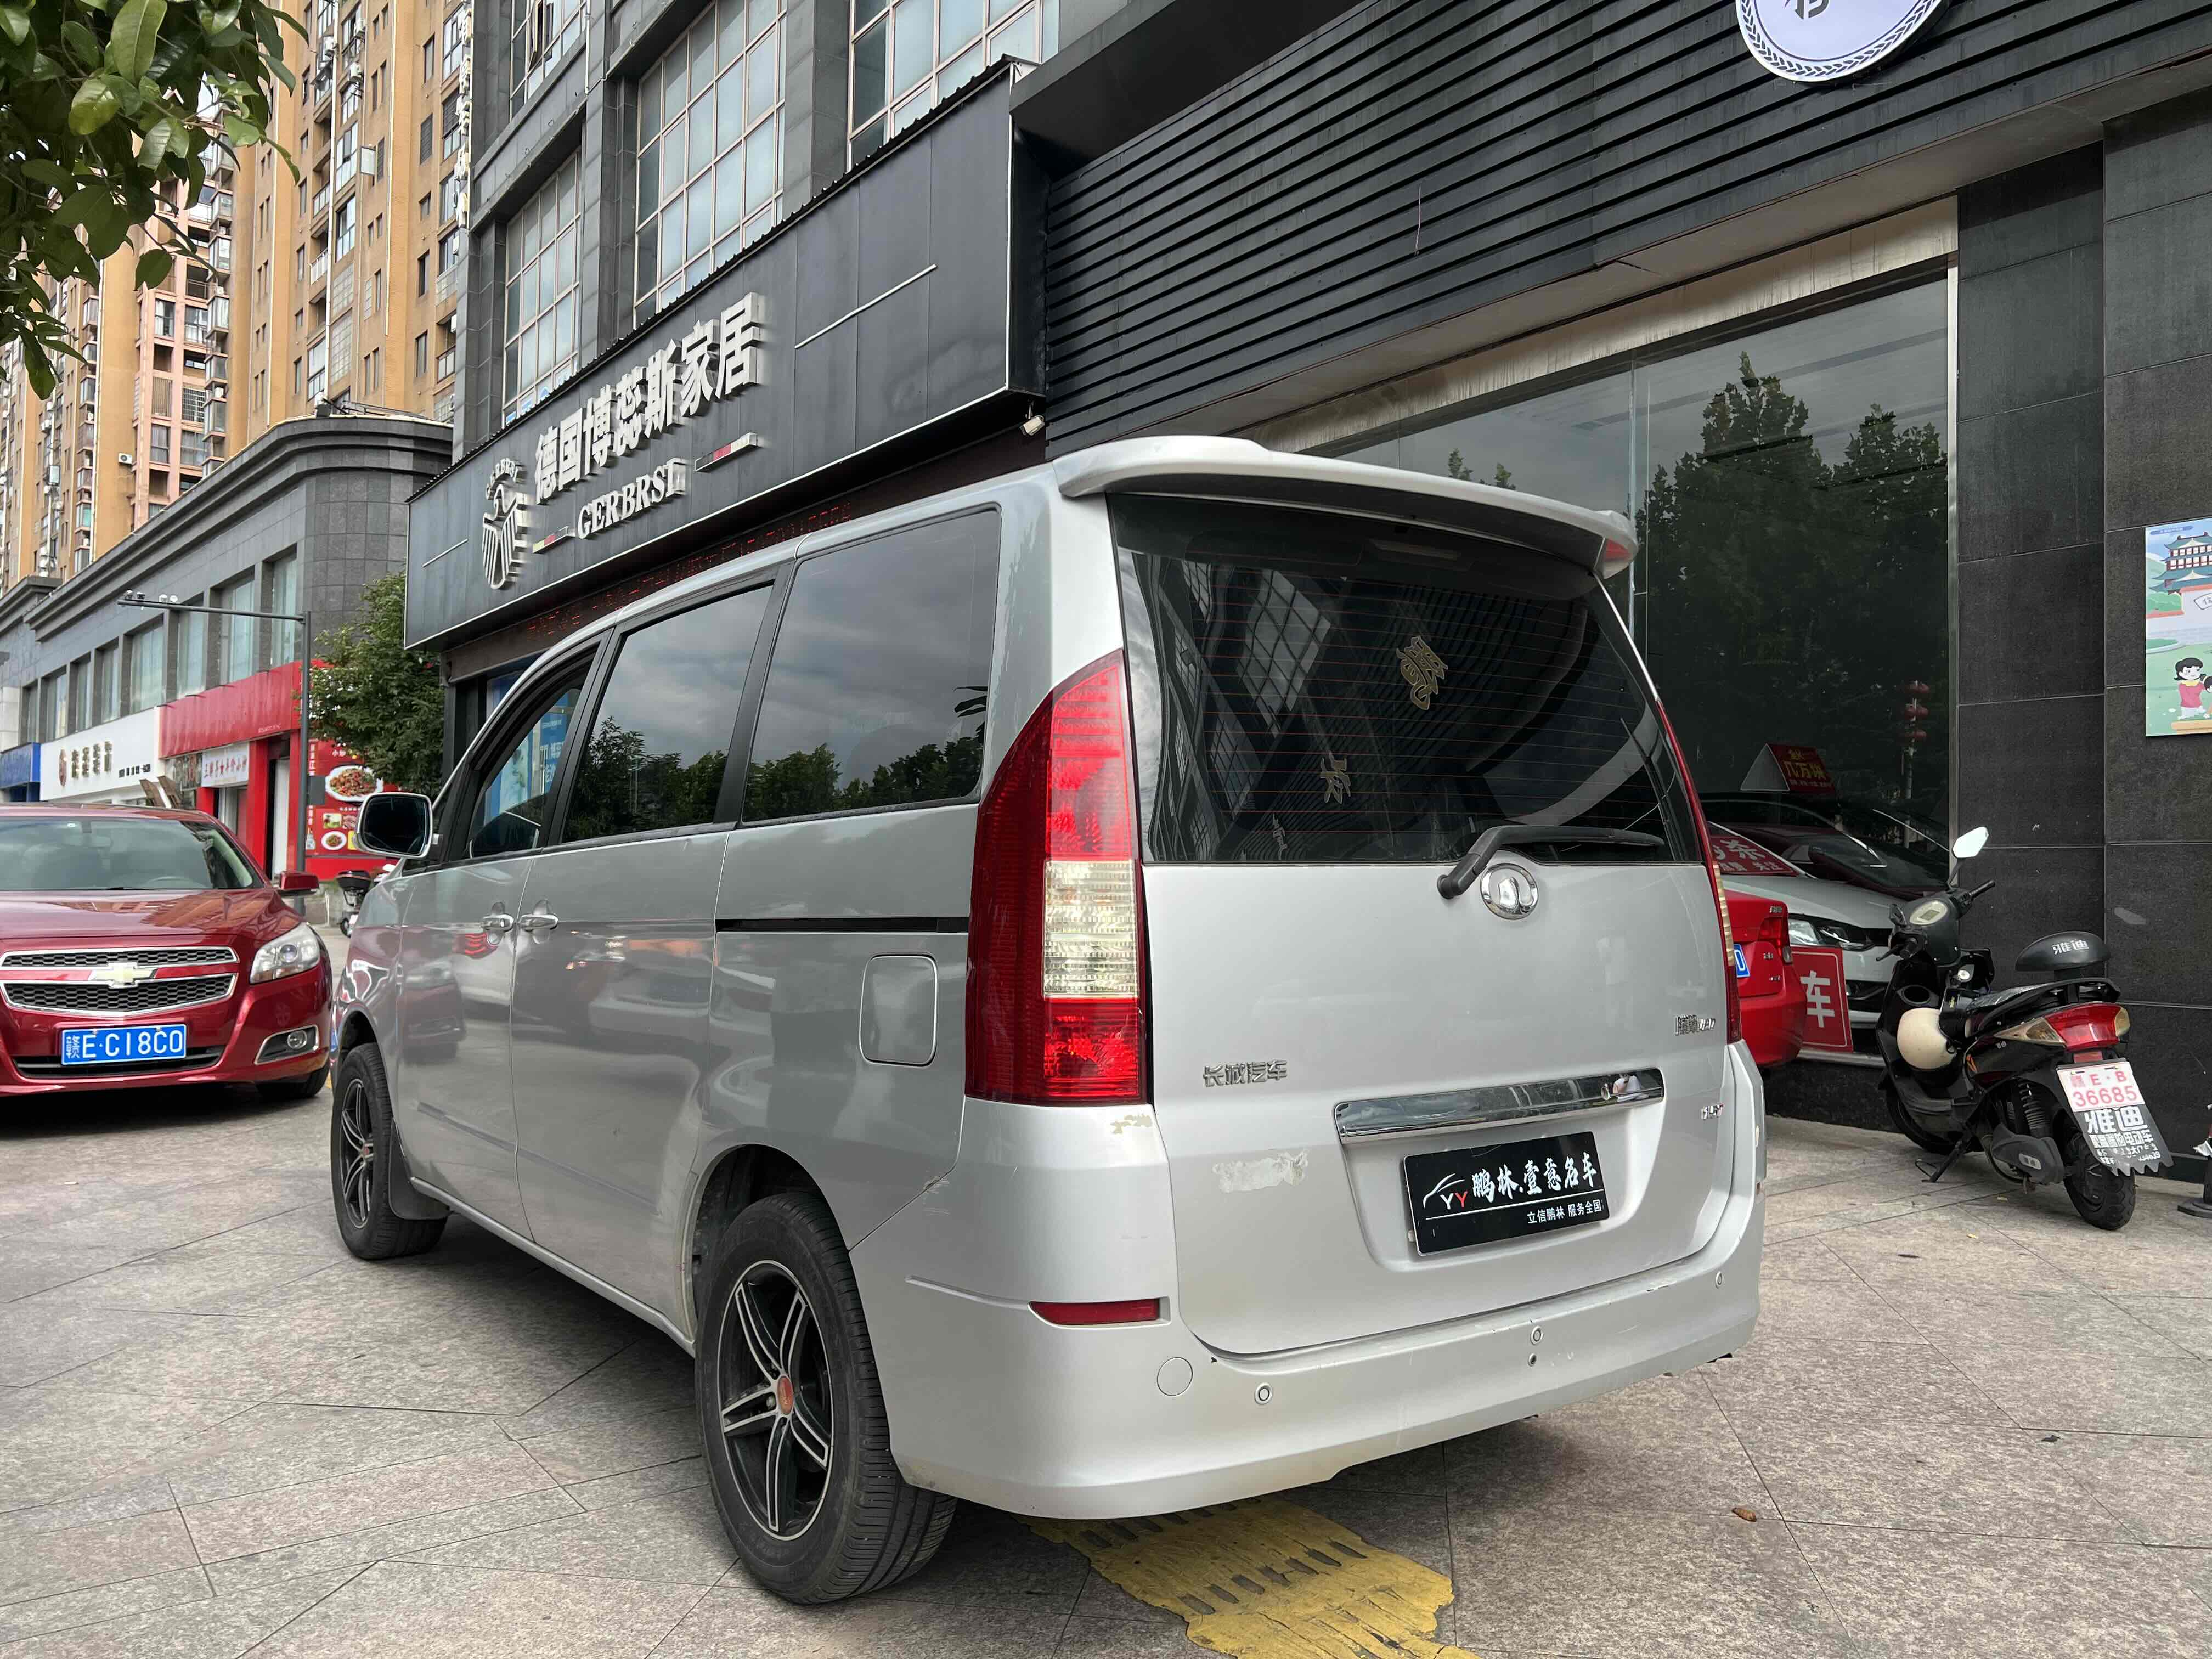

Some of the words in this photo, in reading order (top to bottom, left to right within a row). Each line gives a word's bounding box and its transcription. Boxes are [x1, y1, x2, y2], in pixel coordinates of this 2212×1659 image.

[578, 458, 683, 539] GERBRSI
[2051, 939, 2090, 955] 雅迪
[1203, 1058, 1288, 1088] 长城汽车
[2073, 1085, 2138, 1107] 36685
[2084, 1106, 2148, 1134] 雅迪
[1527, 1206, 1564, 1224] 立信鹏林
[1567, 1199, 1602, 1217] 服务全国
